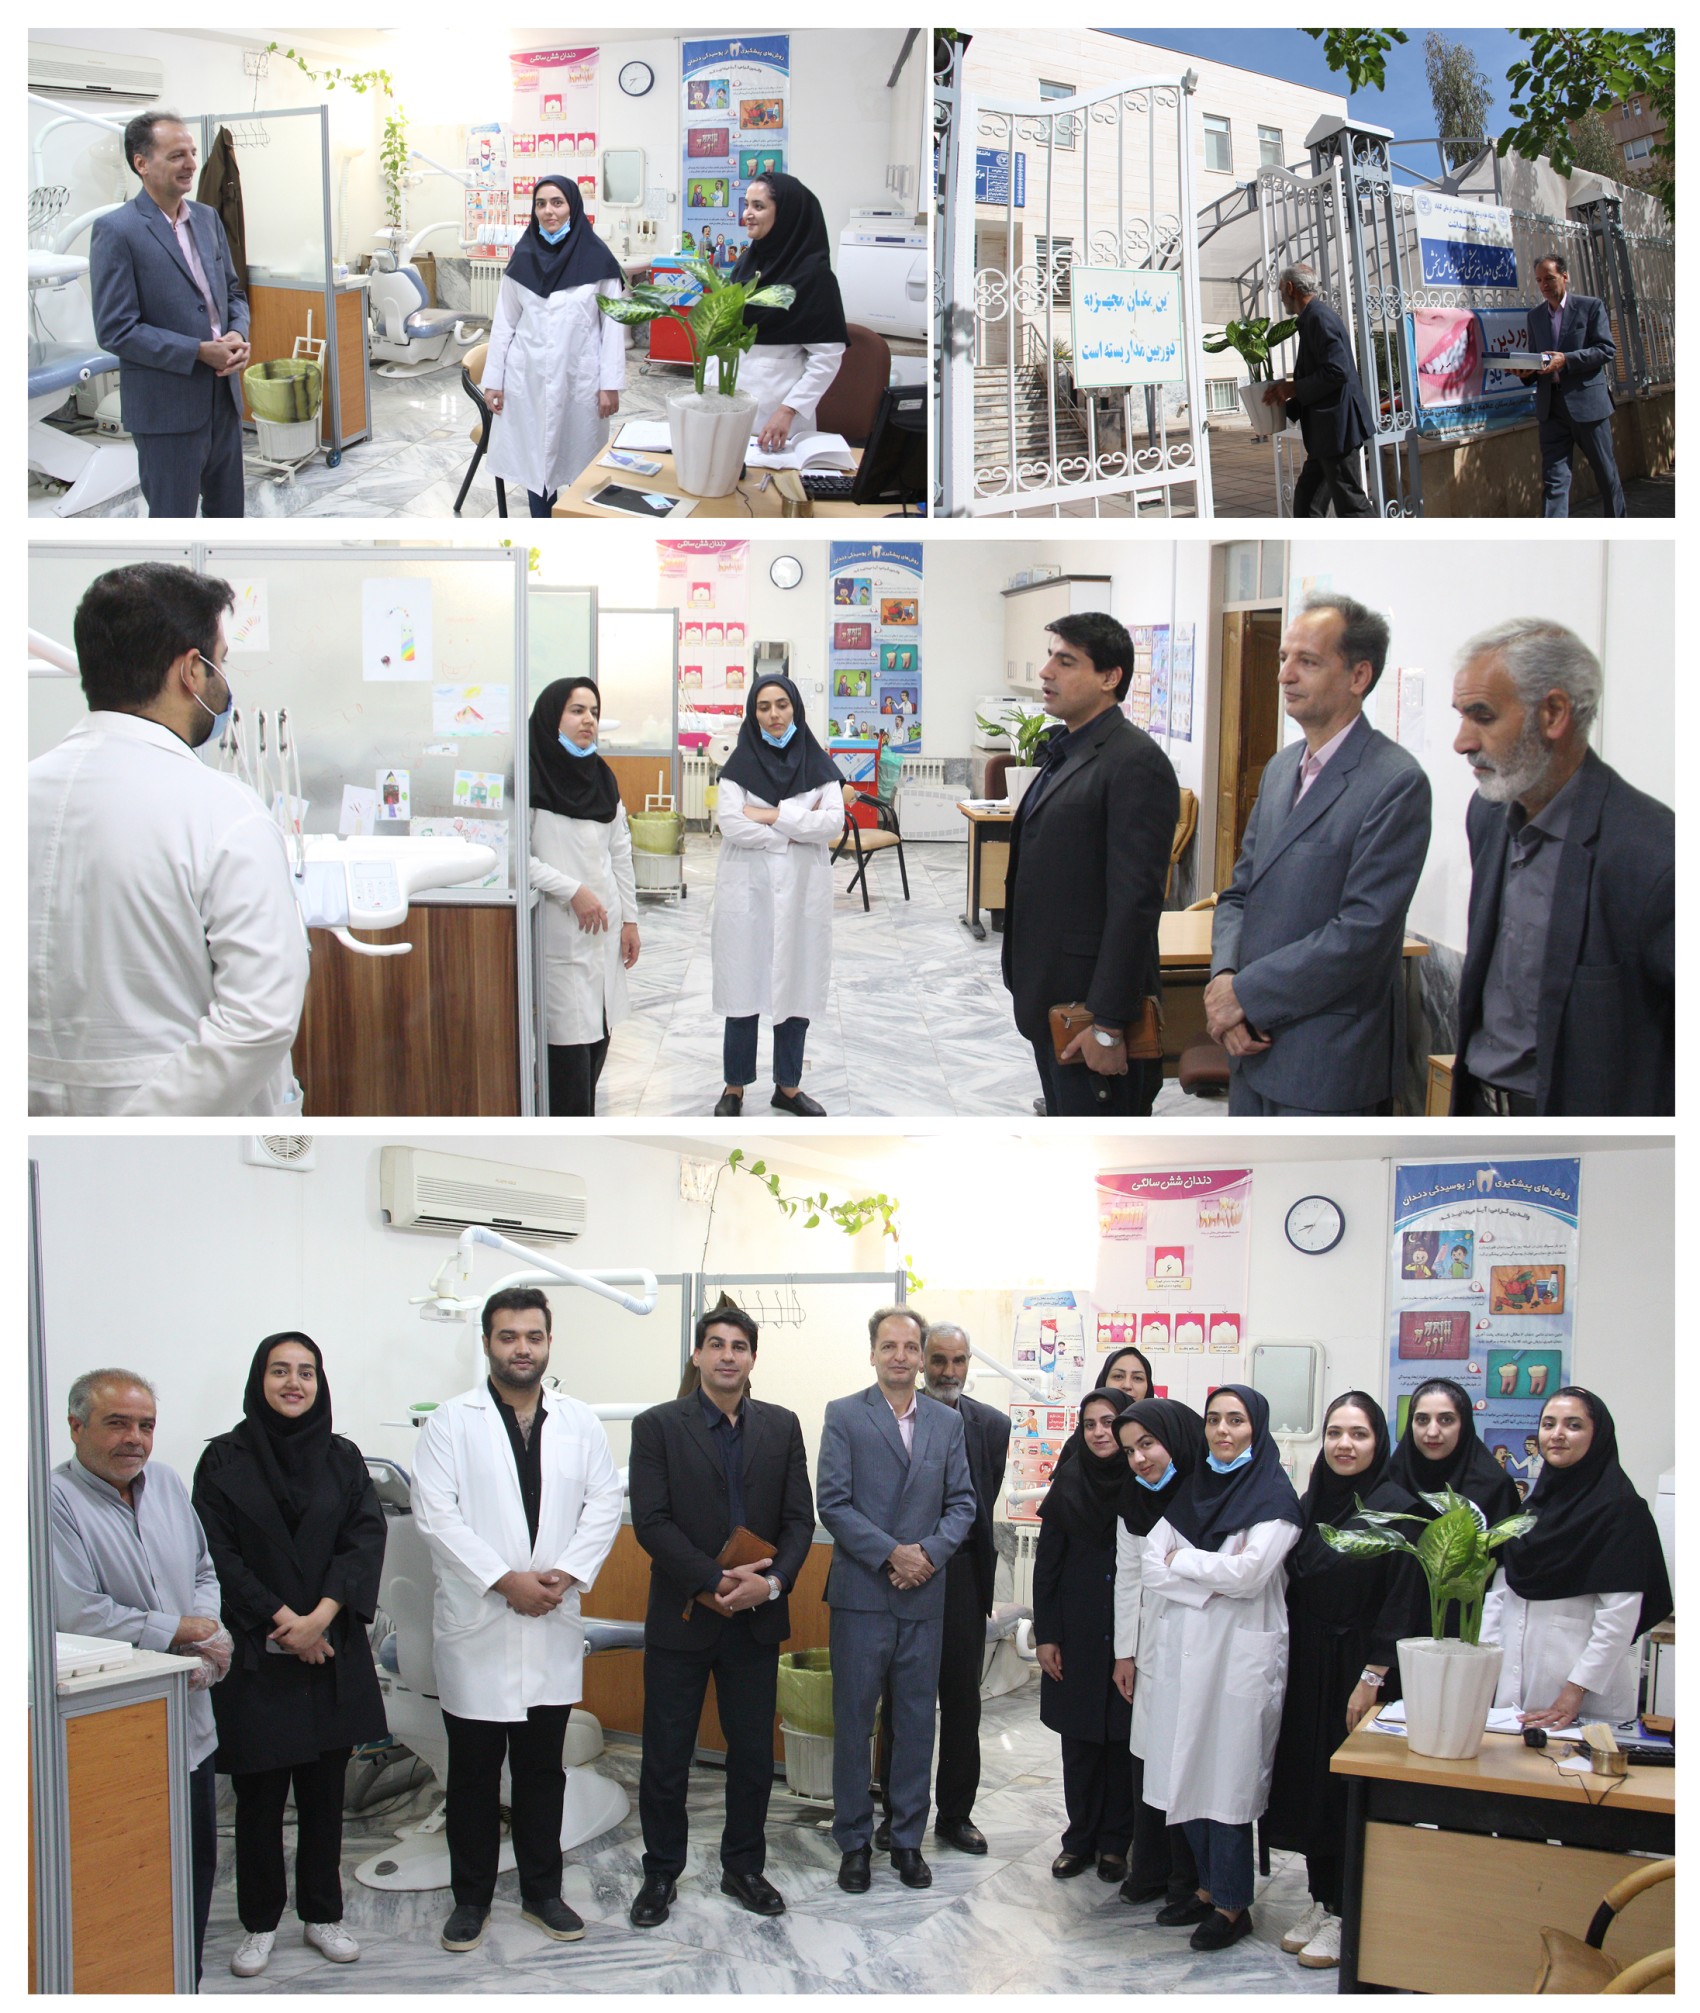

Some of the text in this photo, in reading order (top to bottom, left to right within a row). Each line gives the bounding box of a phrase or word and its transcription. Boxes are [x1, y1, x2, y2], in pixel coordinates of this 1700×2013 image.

[530, 52, 576, 63] دندان شش سالگی
[1426, 250, 1440, 280] بخش
[1084, 294, 1094, 312] به
[1127, 289, 1152, 312] مکان
[1156, 290, 1170, 312] ین
[1082, 339, 1176, 364] دوربین مدار بسته است
[1491, 329, 1528, 352] وردین
[708, 540, 726, 548] دندان
[1131, 1175, 1212, 1192] دندان شش سالگی
[1402, 1178, 1571, 1206] روش‌های پیشگیری از پوسیدگی دندان
[1166, 1264, 1172, 1272] ۶
